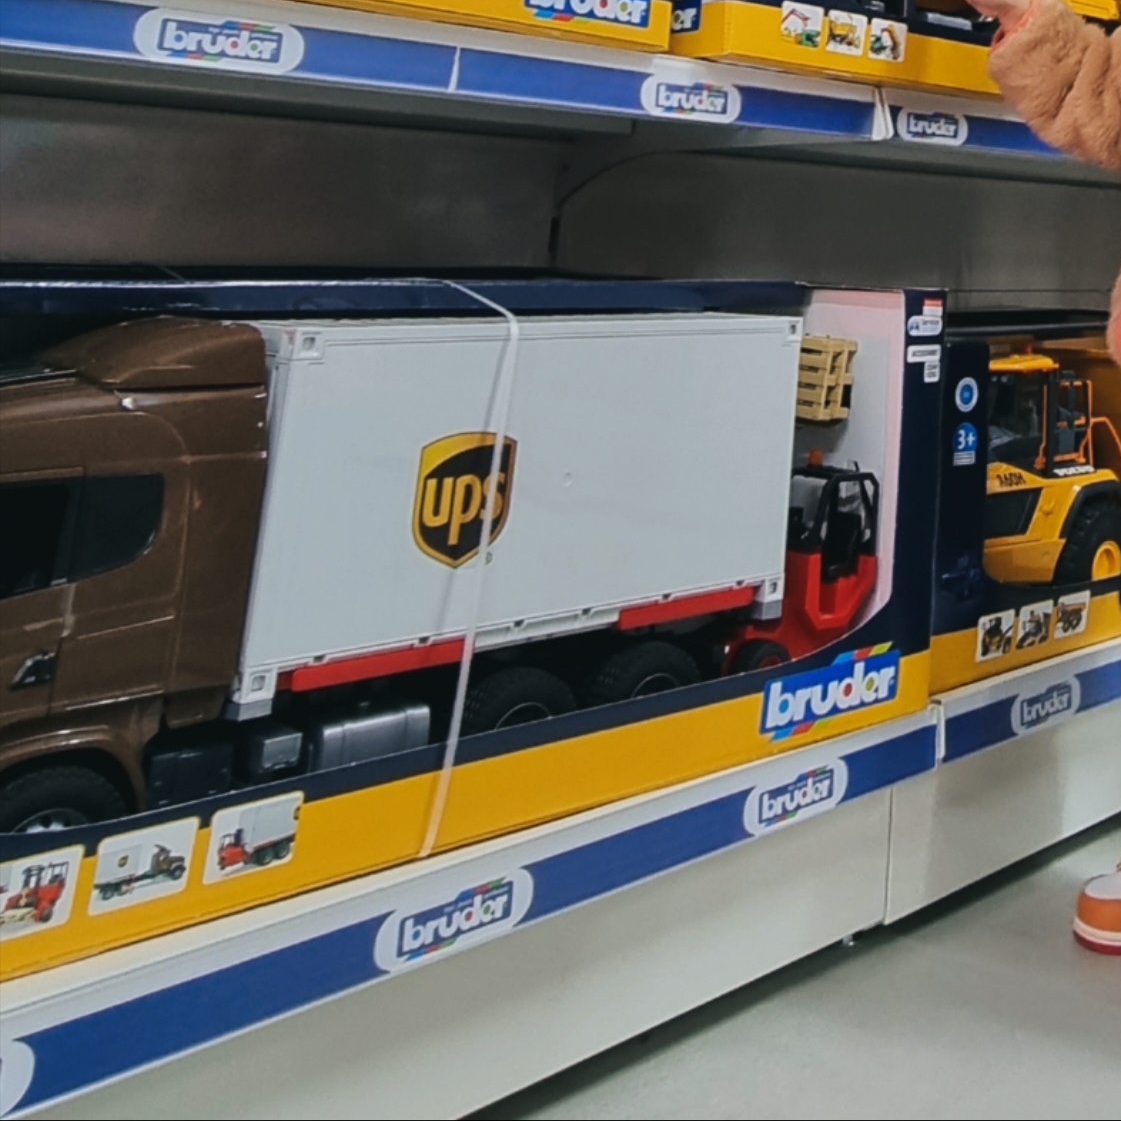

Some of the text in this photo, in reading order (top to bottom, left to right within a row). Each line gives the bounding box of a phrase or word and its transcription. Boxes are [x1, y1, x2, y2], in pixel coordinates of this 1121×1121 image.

[163, 21, 279, 60] bruder
[658, 85, 726, 114] bruder
[906, 112, 958, 138] bruder
[958, 430, 975, 449] 3+
[422, 475, 506, 546] ups
[766, 663, 897, 729] bruder
[1021, 687, 1072, 728] bruder
[761, 774, 835, 825] bruder
[402, 892, 511, 957] bruder
